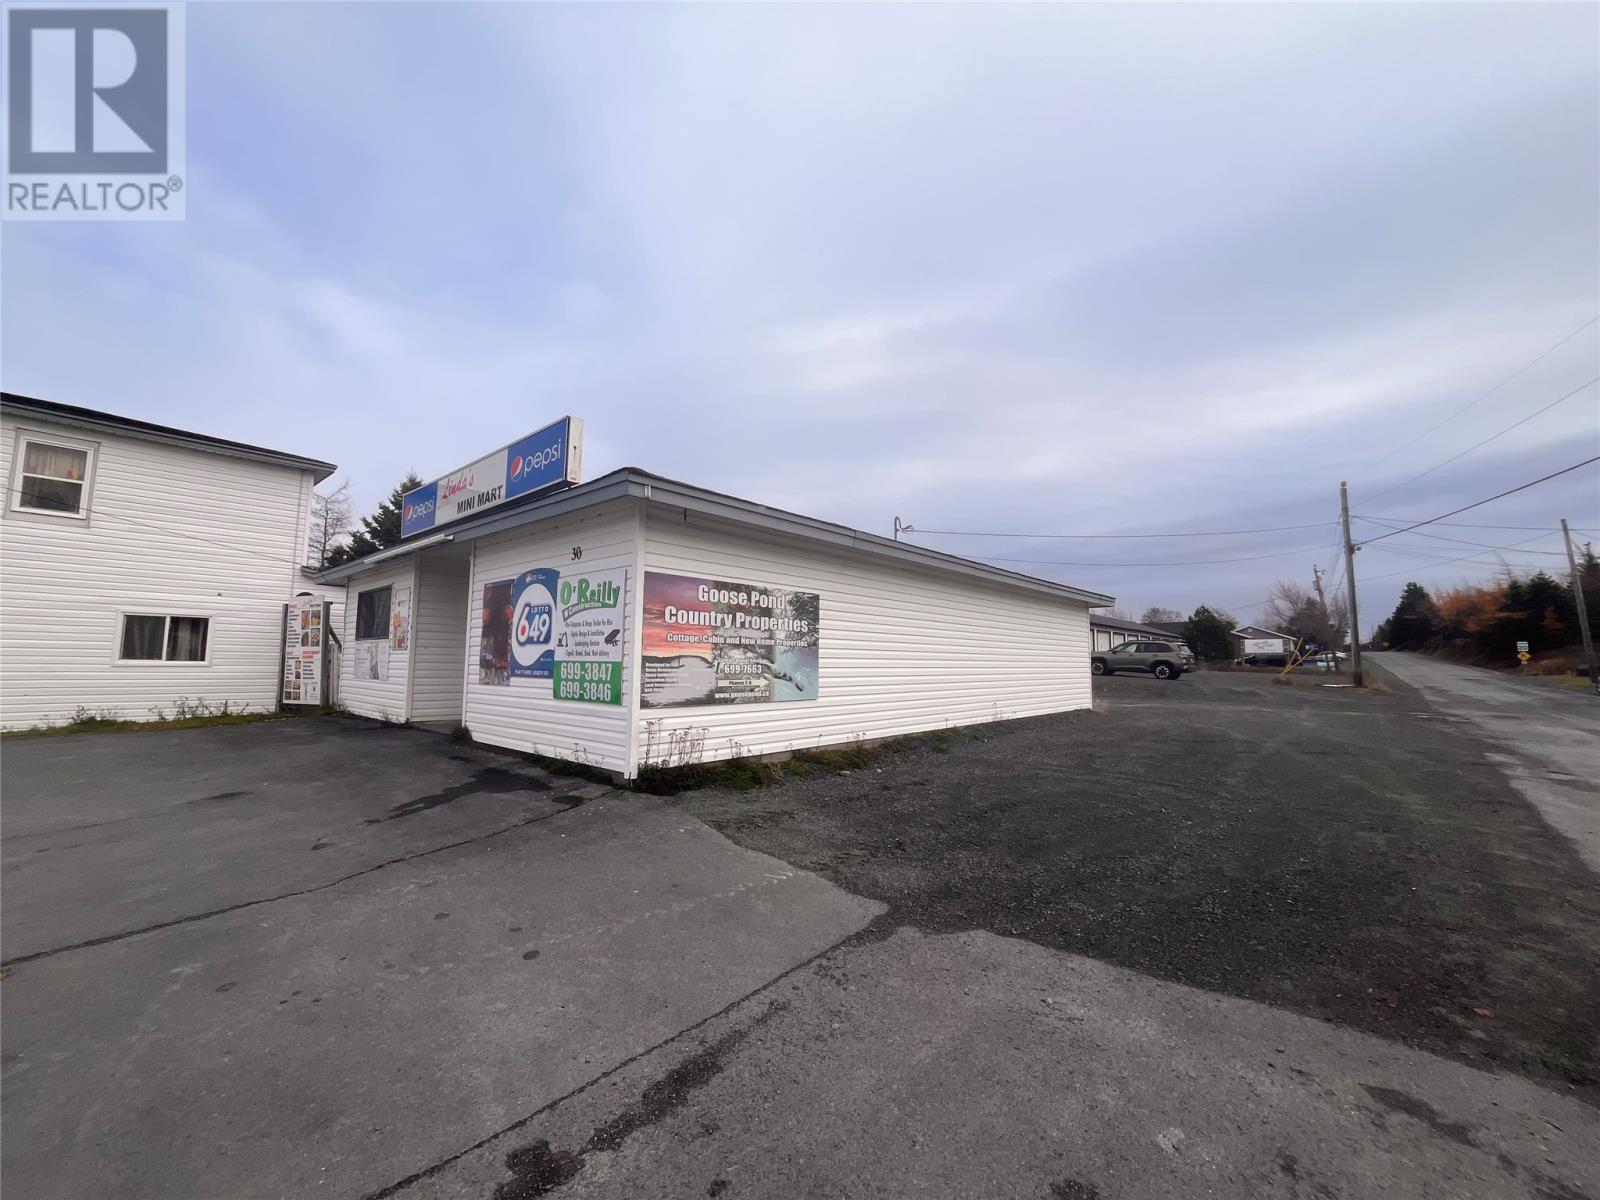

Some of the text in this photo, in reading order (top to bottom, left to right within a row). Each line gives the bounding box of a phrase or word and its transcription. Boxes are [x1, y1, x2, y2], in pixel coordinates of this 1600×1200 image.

[523, 437, 562, 478] pepsi
[441, 471, 475, 501] Linda's
[412, 495, 435, 521] pepsi
[456, 484, 504, 516] MINI MART
[571, 546, 582, 561] 30
[559, 577, 621, 608] O'Reilly
[698, 584, 785, 609] Goose Pond
[531, 606, 549, 614] LOTTO
[568, 601, 602, 615] Construction
[664, 605, 810, 633] Country Properties
[667, 633, 701, 645] Cottage,
[702, 634, 725, 645] Cabin
[725, 636, 739, 645] and
[740, 637, 756, 646] New
[776, 639, 808, 648] Properties
[560, 662, 613, 681] 699-3847
[560, 680, 611, 702] 699-3846
